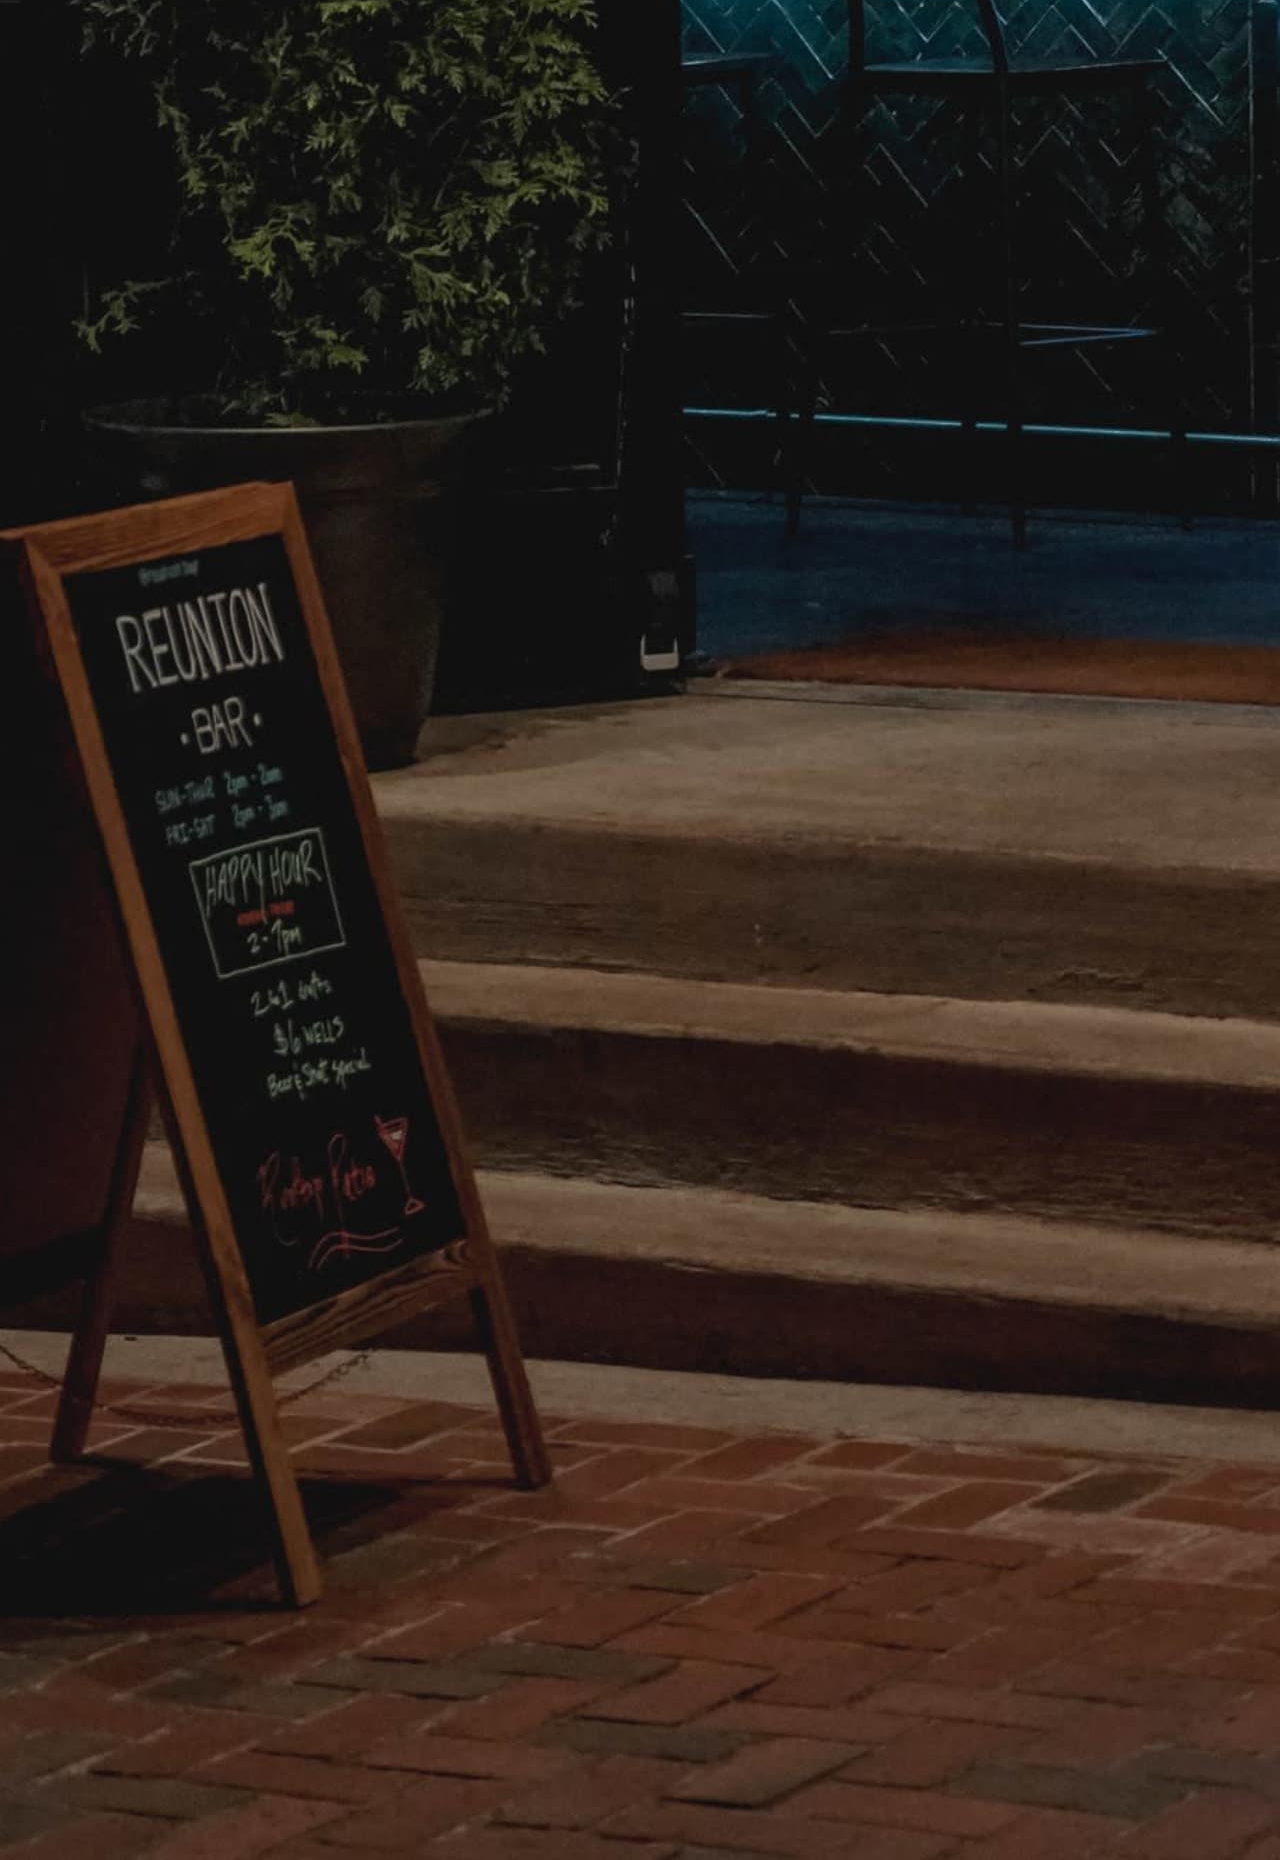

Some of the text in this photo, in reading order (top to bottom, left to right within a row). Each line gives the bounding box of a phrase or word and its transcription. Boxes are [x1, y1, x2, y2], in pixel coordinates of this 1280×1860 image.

[115, 581, 285, 693] REUNION
[191, 695, 254, 755] BAR
[205, 850, 267, 923] HAPPY
[270, 839, 322, 896] HOUR
